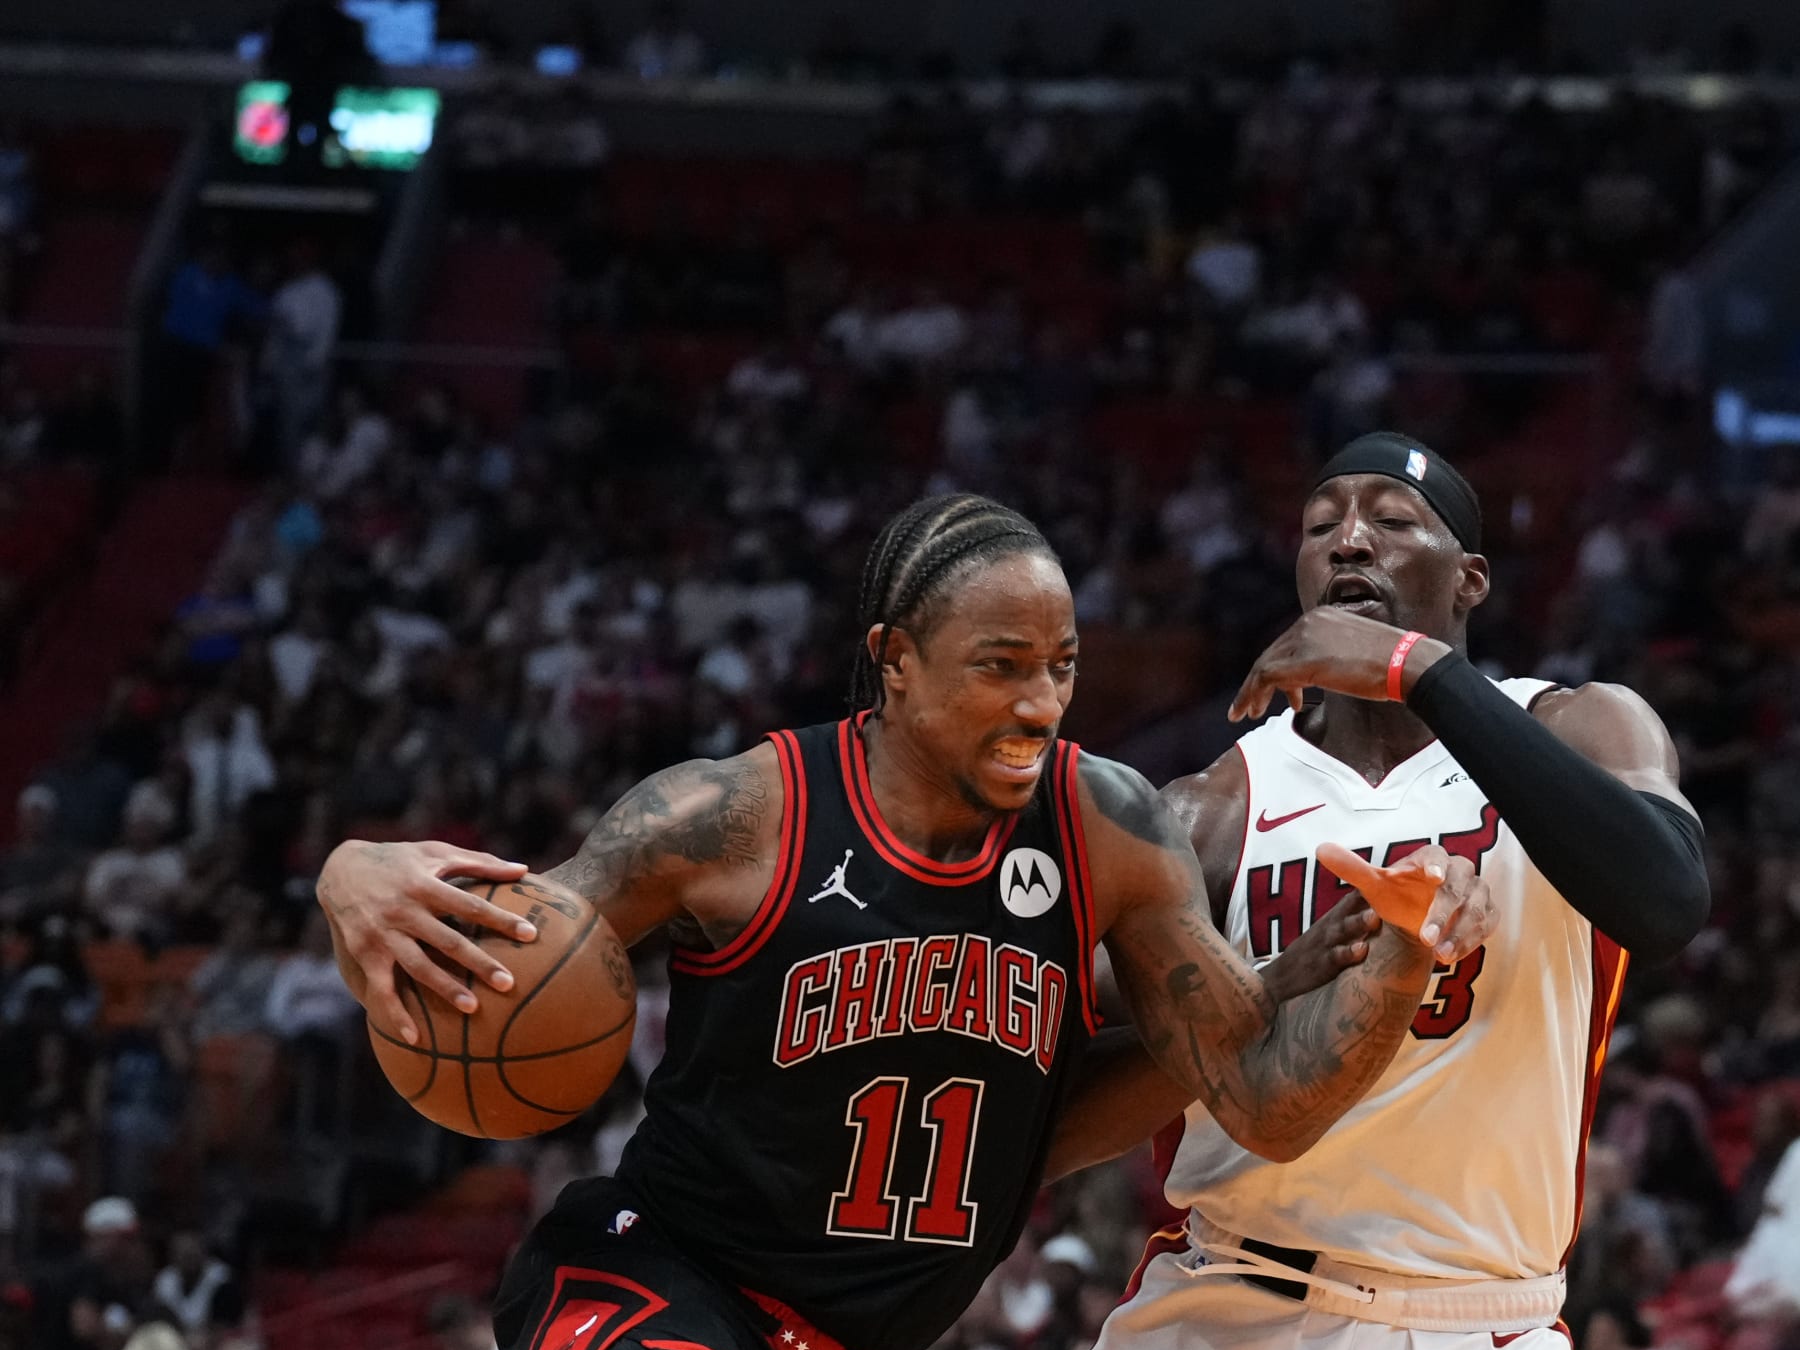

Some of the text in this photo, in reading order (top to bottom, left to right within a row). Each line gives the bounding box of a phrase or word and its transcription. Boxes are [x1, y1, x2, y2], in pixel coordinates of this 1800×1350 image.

[1247, 802, 1499, 958] HET
[772, 933, 1067, 1075] CHICAGO
[826, 1076, 985, 1247] 11
